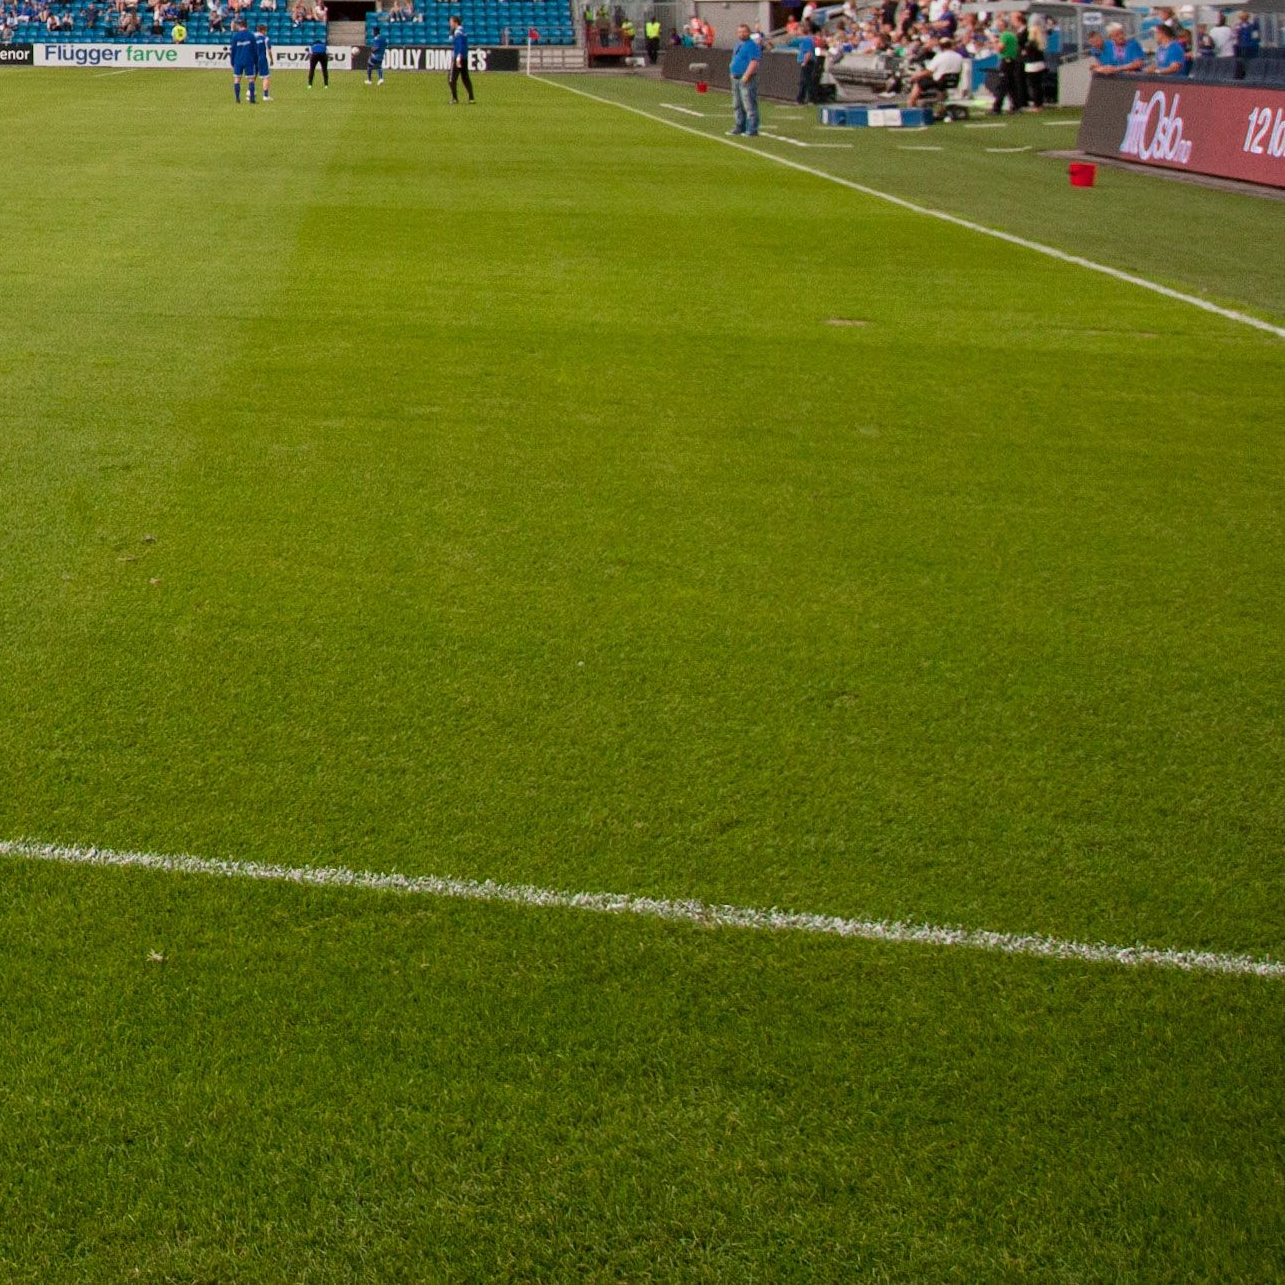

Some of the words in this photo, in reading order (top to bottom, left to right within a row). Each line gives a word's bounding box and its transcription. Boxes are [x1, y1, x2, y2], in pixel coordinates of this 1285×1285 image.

[44, 45, 121, 65] Flügger
[126, 45, 178, 62] farve
[382, 49, 422, 70] DOLLY
[425, 49, 487, 71] DIME'S
[1242, 107, 1272, 154] 12
